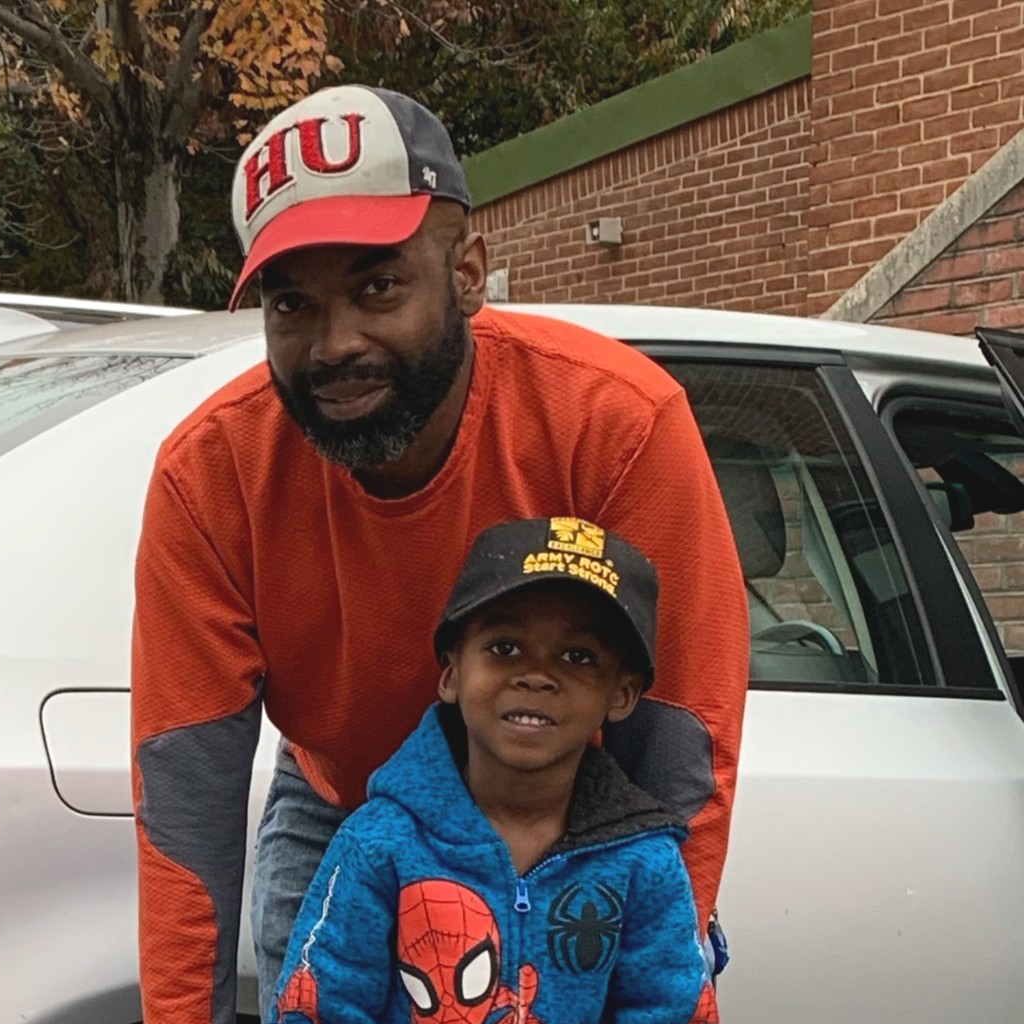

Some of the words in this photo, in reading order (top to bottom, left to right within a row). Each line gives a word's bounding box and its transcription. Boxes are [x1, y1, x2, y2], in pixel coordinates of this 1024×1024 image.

[244, 112, 365, 222] HU
[522, 561, 566, 574] Start
[523, 552, 575, 564] ARMY
[579, 557, 620, 586] ROTC
